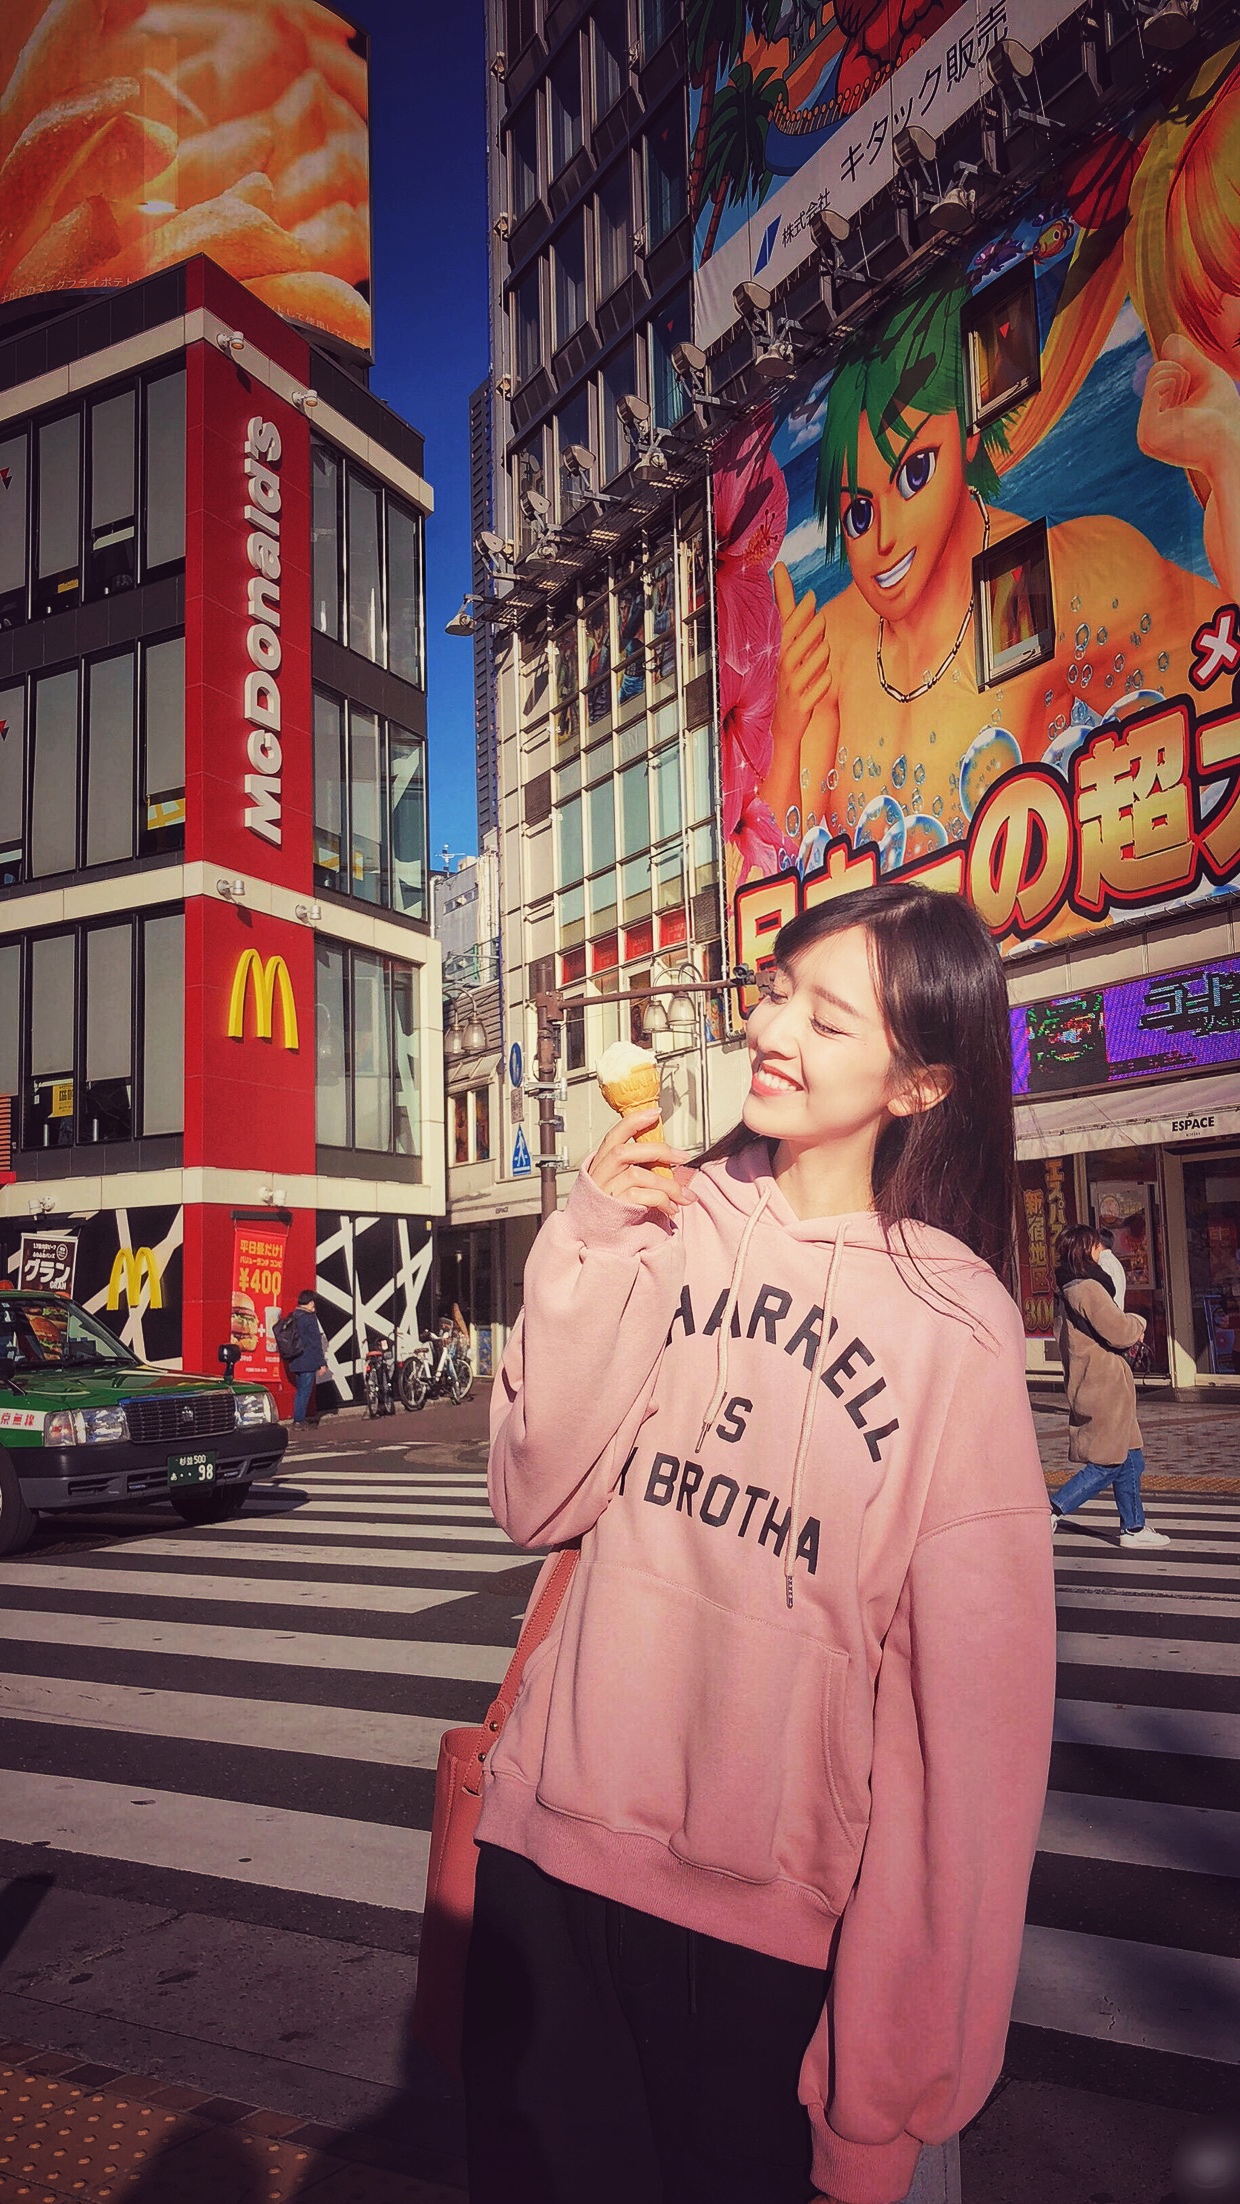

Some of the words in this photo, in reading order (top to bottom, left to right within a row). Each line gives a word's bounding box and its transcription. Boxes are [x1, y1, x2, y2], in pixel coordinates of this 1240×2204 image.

[781, 188, 831, 248] 株式会社
[839, 2, 1007, 183] キタック販売
[1, 274, 140, 302] ナルドのマックフライポテト
[244, 416, 283, 845] McDonald's
[1171, 1116, 1215, 1132] ESPACE
[24, 1258, 71, 1283] グラン
[1023, 1189, 1050, 1293] 新宿地区
[239, 1267, 282, 1296] ¥400
[643, 1451, 821, 1576] BROTHA
